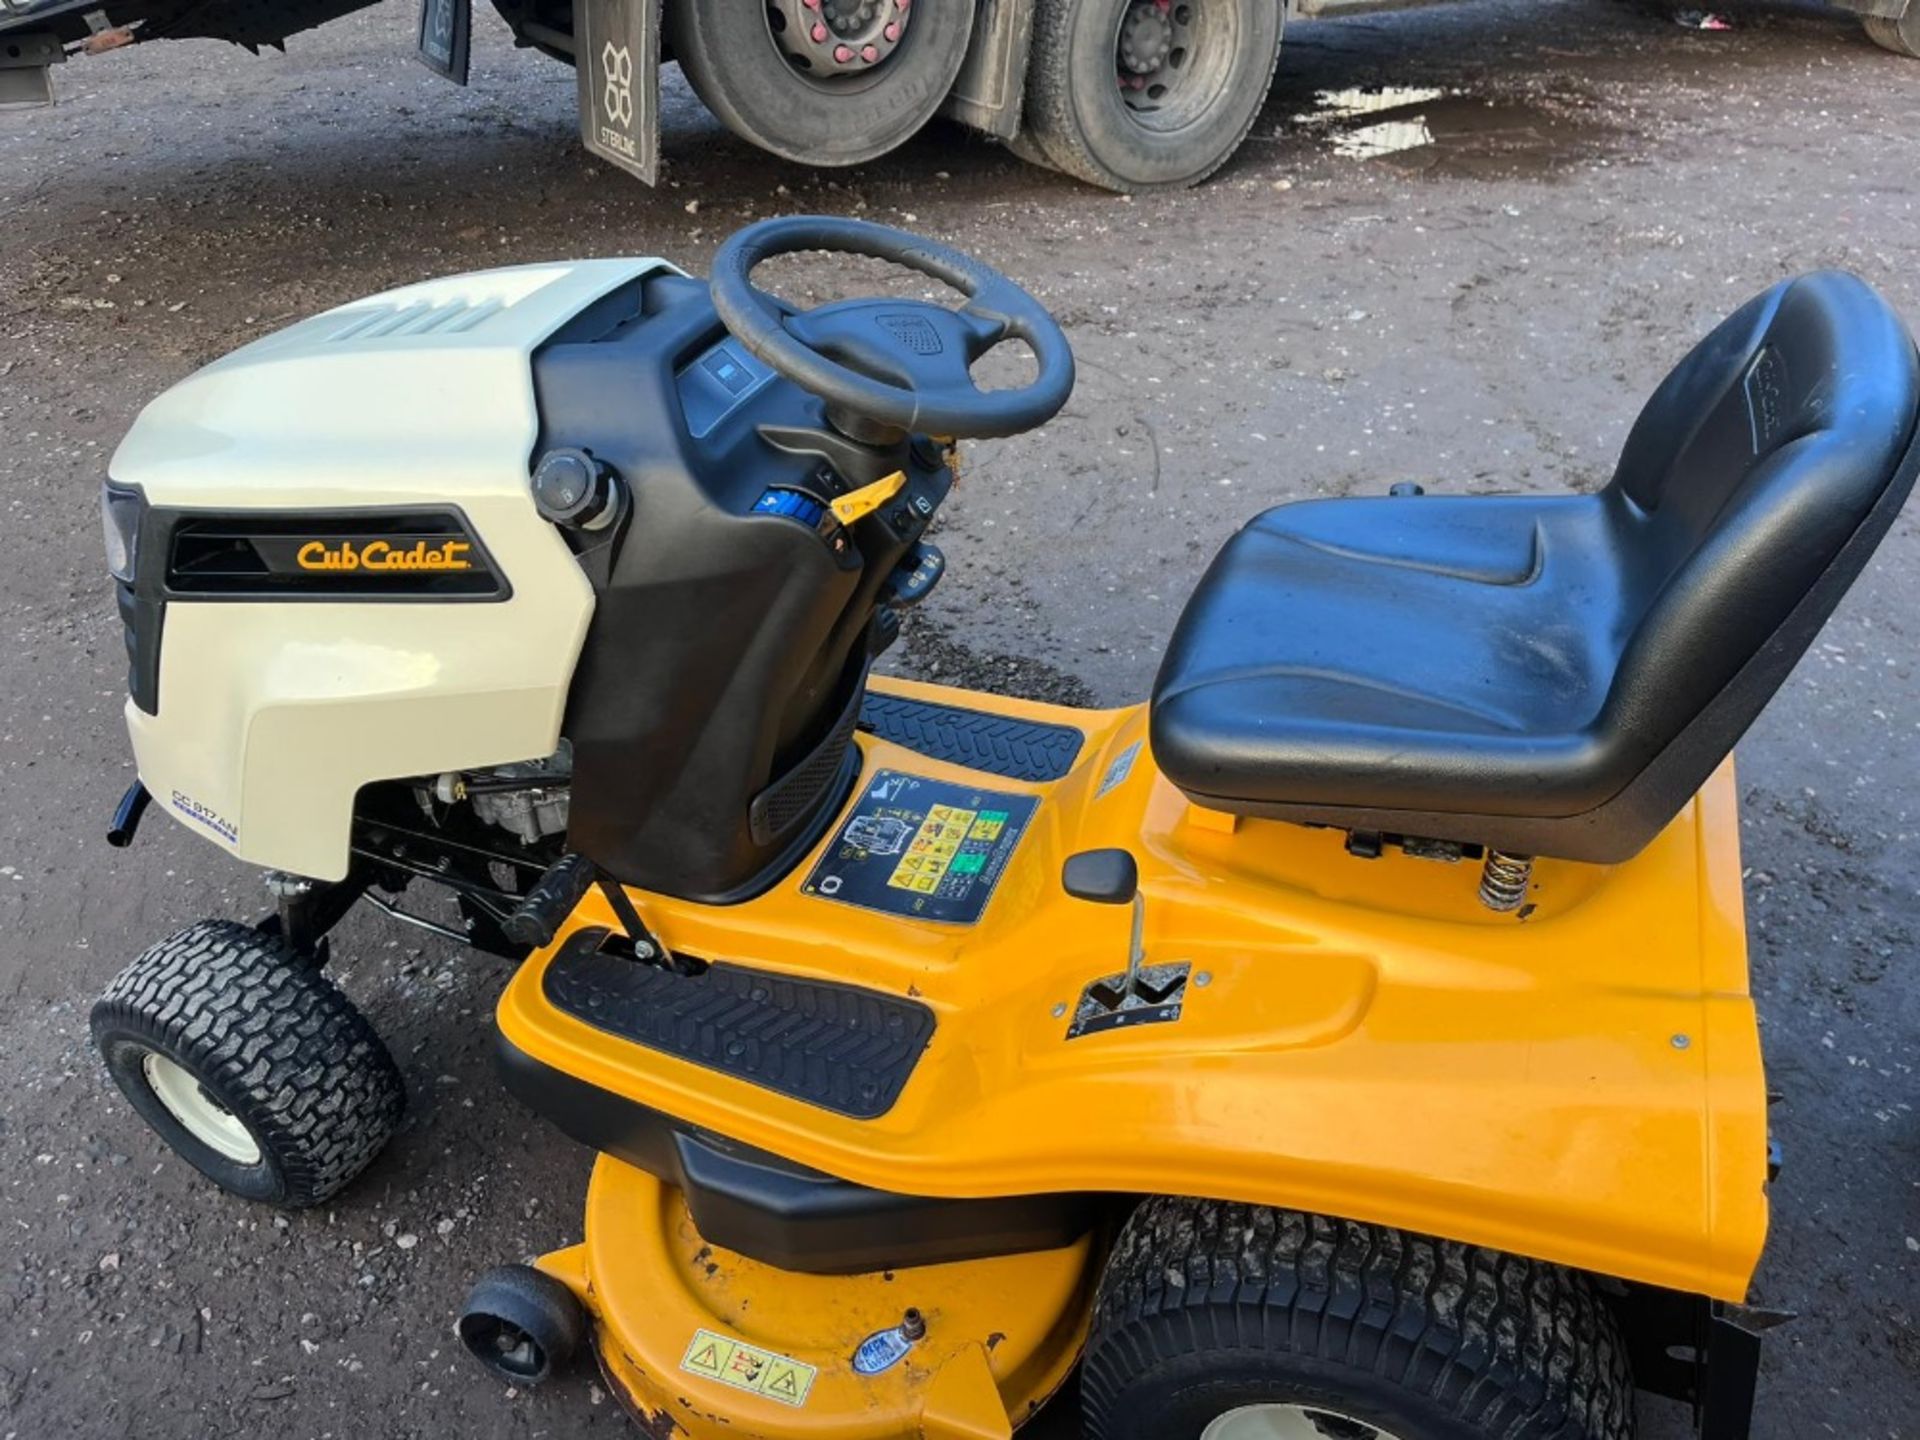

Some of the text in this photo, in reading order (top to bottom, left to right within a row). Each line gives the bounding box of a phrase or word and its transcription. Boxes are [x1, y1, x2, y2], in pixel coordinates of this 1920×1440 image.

[297, 541, 470, 570] Cub Cadet
[172, 790, 191, 806] CC
[193, 802, 217, 819] 917
